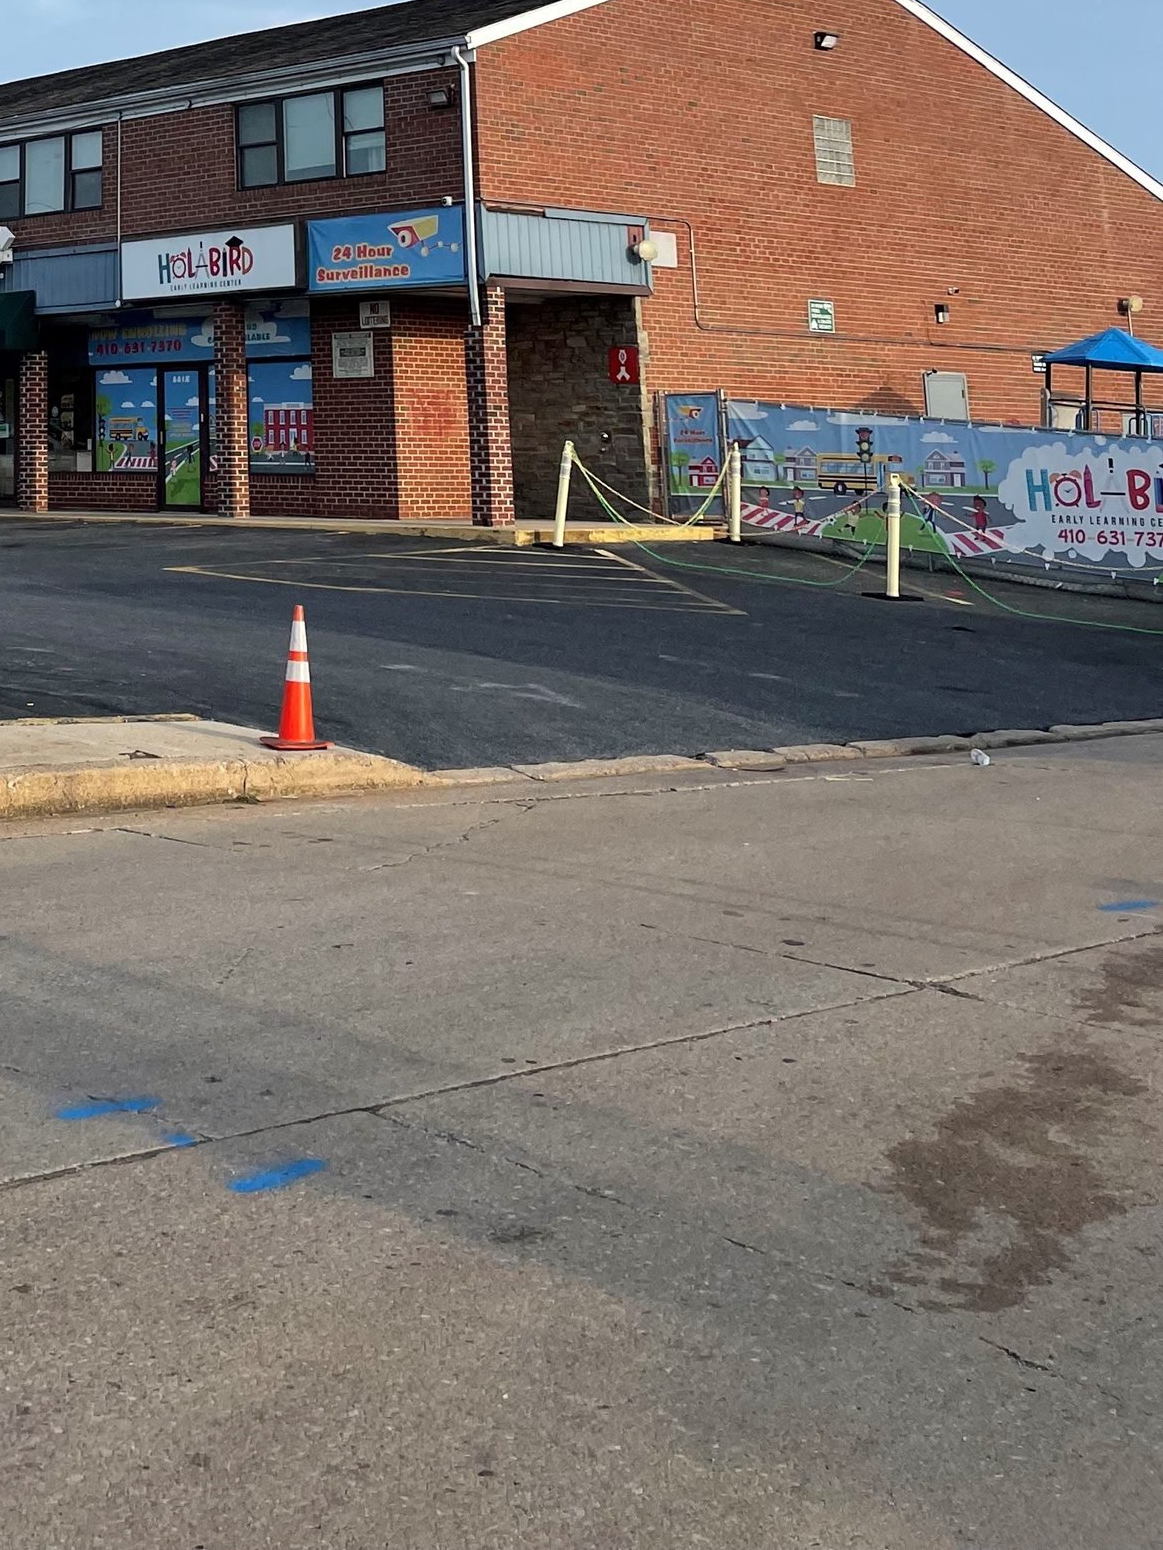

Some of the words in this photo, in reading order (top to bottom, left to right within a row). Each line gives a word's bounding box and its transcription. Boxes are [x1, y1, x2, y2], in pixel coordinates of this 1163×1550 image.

[158, 238, 253, 284] HOLABIRD
[332, 245, 353, 262] 24
[356, 242, 394, 259] Hour
[316, 264, 410, 284] Surveillance
[170, 284, 187, 292] EARLY
[189, 281, 218, 290] LEARNING
[220, 279, 242, 288] CENTER
[1052, 515, 1084, 524] EARLY
[1089, 517, 1145, 527] LEARNING
